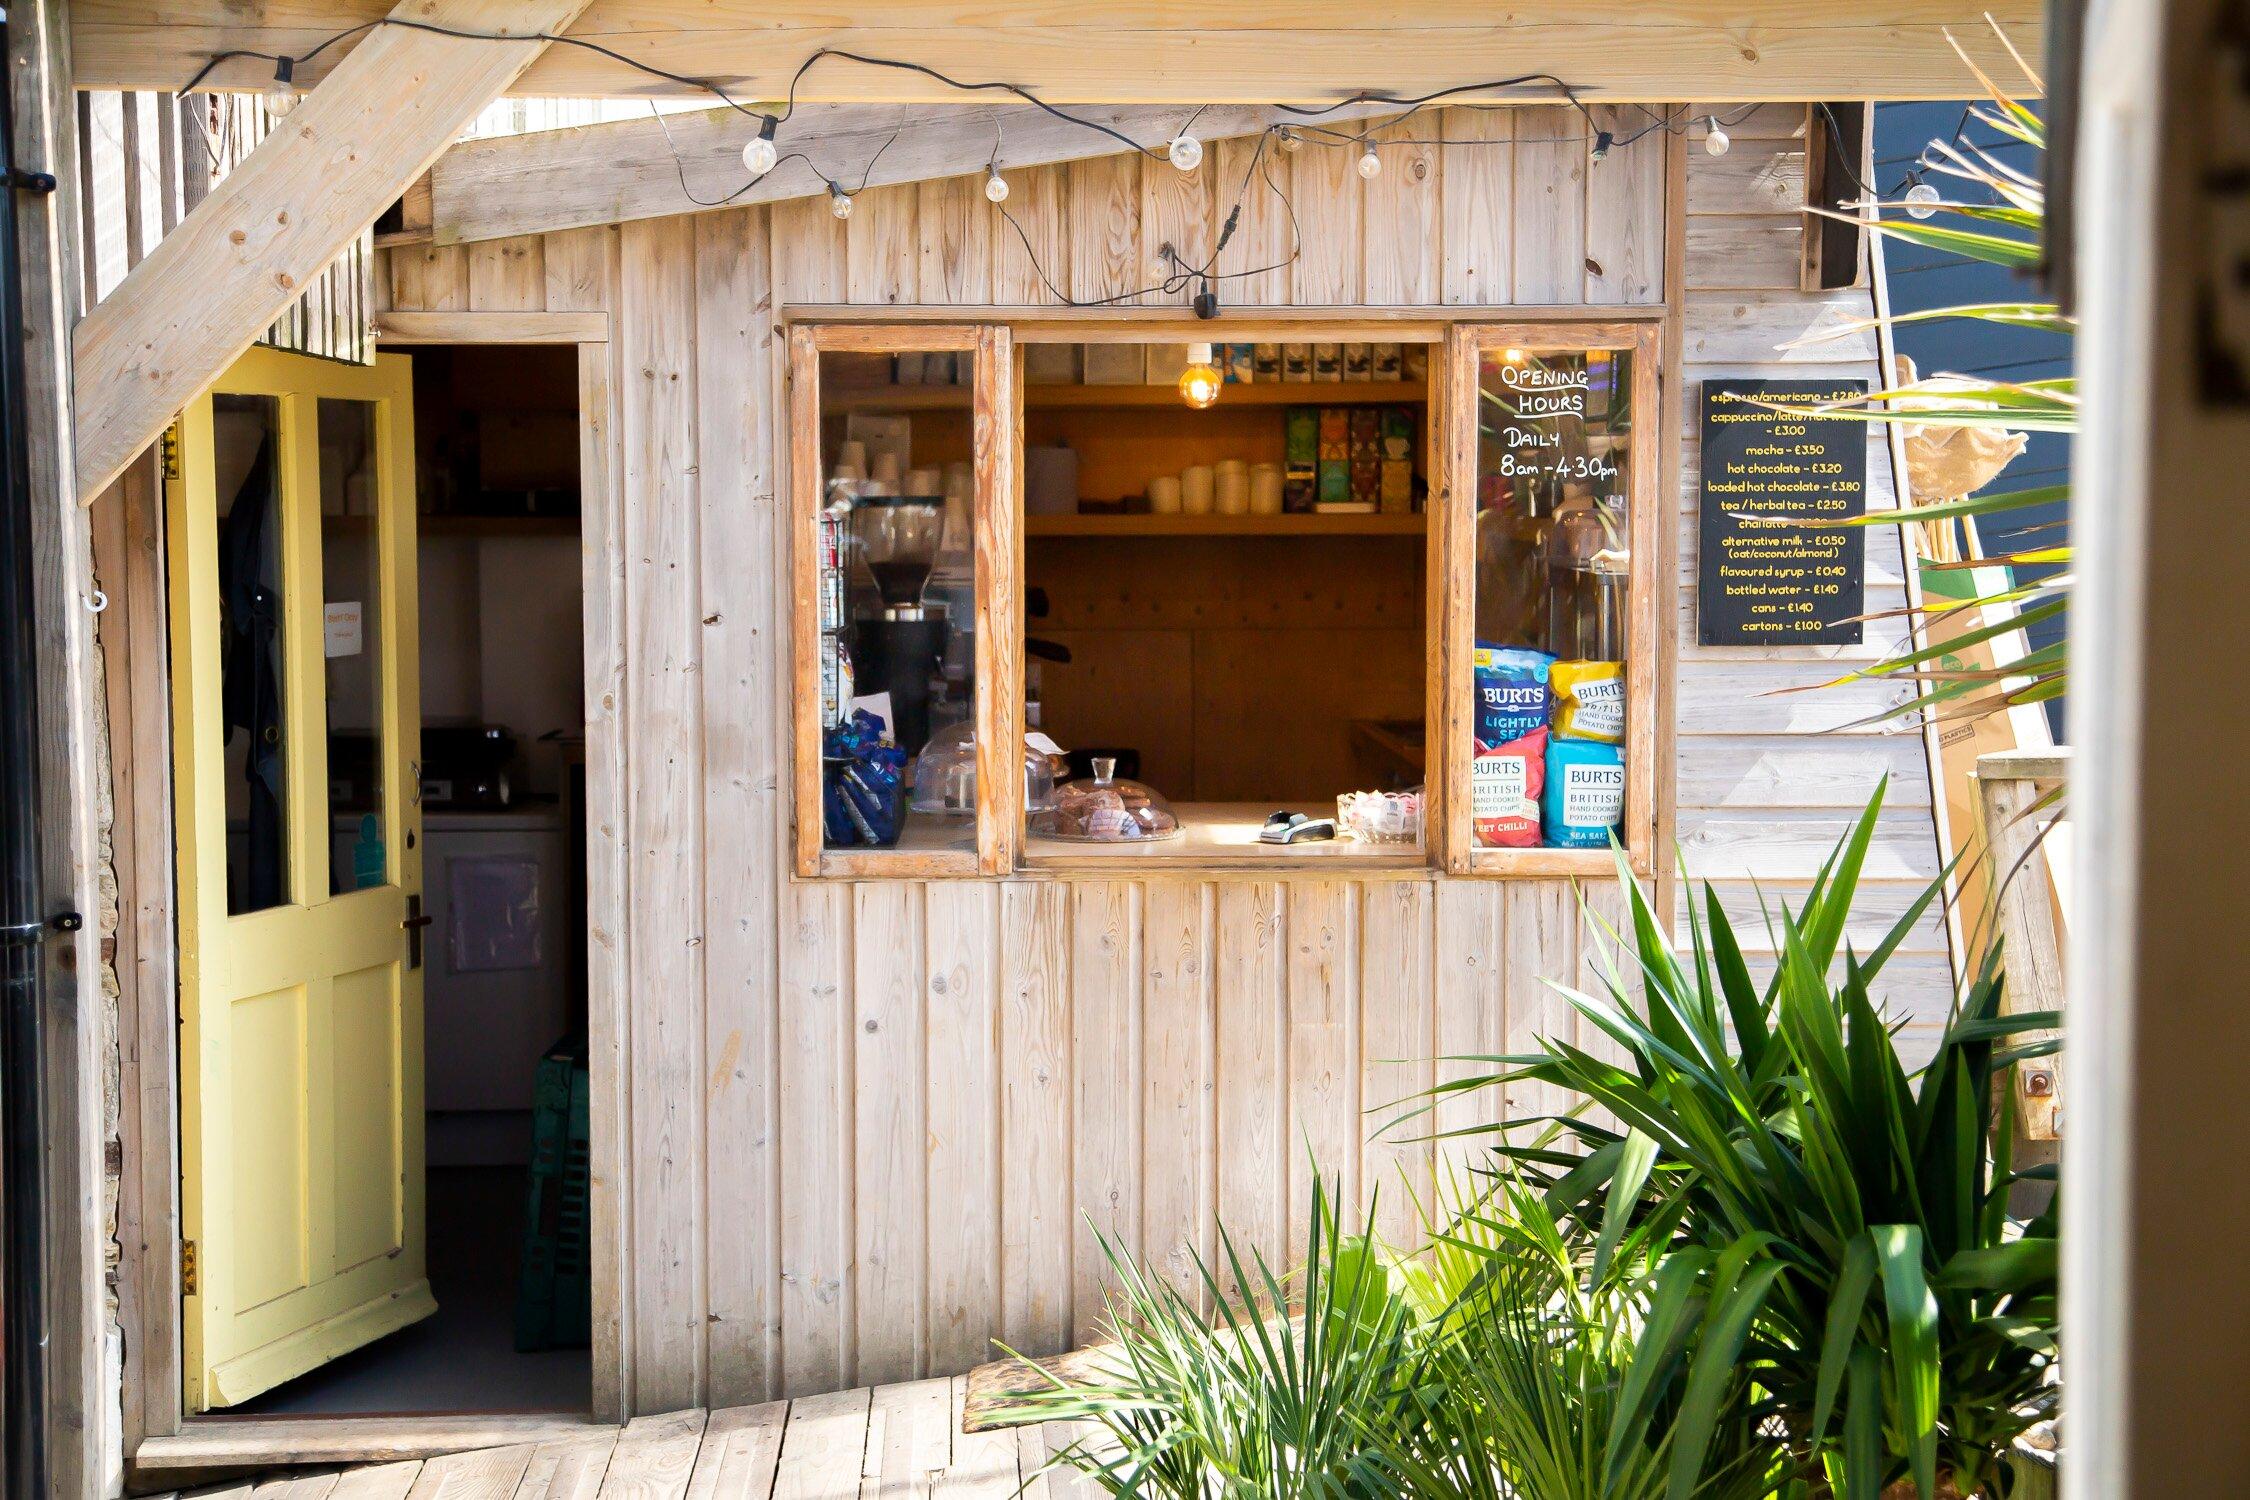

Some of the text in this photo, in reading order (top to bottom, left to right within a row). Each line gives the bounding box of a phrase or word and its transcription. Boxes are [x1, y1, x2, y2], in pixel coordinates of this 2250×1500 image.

[1501, 366, 1589, 386] OPENING
[1519, 394, 1583, 413] HOURS
[1774, 425, 1806, 436] £3.00
[1502, 427, 1560, 448] DAILY
[1745, 444, 1784, 456] mocha
[1794, 445, 1825, 456] £3.50
[1500, 454, 1539, 477] 8am
[1727, 462, 1745, 474] hot
[1747, 462, 1801, 474] chocolate
[1812, 463, 1842, 474] £3.20
[1707, 480, 1745, 492] loaded
[1747, 480, 1765, 492] hot
[1767, 480, 1820, 492] chocolate
[1831, 481, 1860, 492] £3.80
[1720, 500, 1740, 510] tea
[1749, 499, 1785, 510] herbal
[1787, 500, 1806, 510] tea
[1817, 500, 1847, 511] £2.50
[1721, 536, 1780, 547] alternative
[1782, 535, 1803, 546] milk
[1815, 536, 1846, 546] £0.50
[1720, 565, 1773, 577] flavoured
[1774, 568, 1805, 578] syrup
[1815, 566, 1847, 577] £0.40
[1726, 584, 1766, 595] bottled
[1768, 585, 1801, 595] water
[1813, 584, 1839, 594] £1.40
[1751, 604, 1777, 613] cans
[1788, 602, 1814, 613] £1.40
[1741, 621, 1784, 631] cartons
[1794, 620, 1822, 631] £1.00
[1483, 687, 1545, 704] BURTS
[1578, 682, 1624, 700] BURTS
[1485, 715, 1542, 728] LIGHTLY
[1571, 770, 1622, 784] BURTS
[1570, 794, 1620, 803] BRITISH
[1498, 821, 1528, 832] CHILLI
[1570, 832, 1586, 840] SEA
